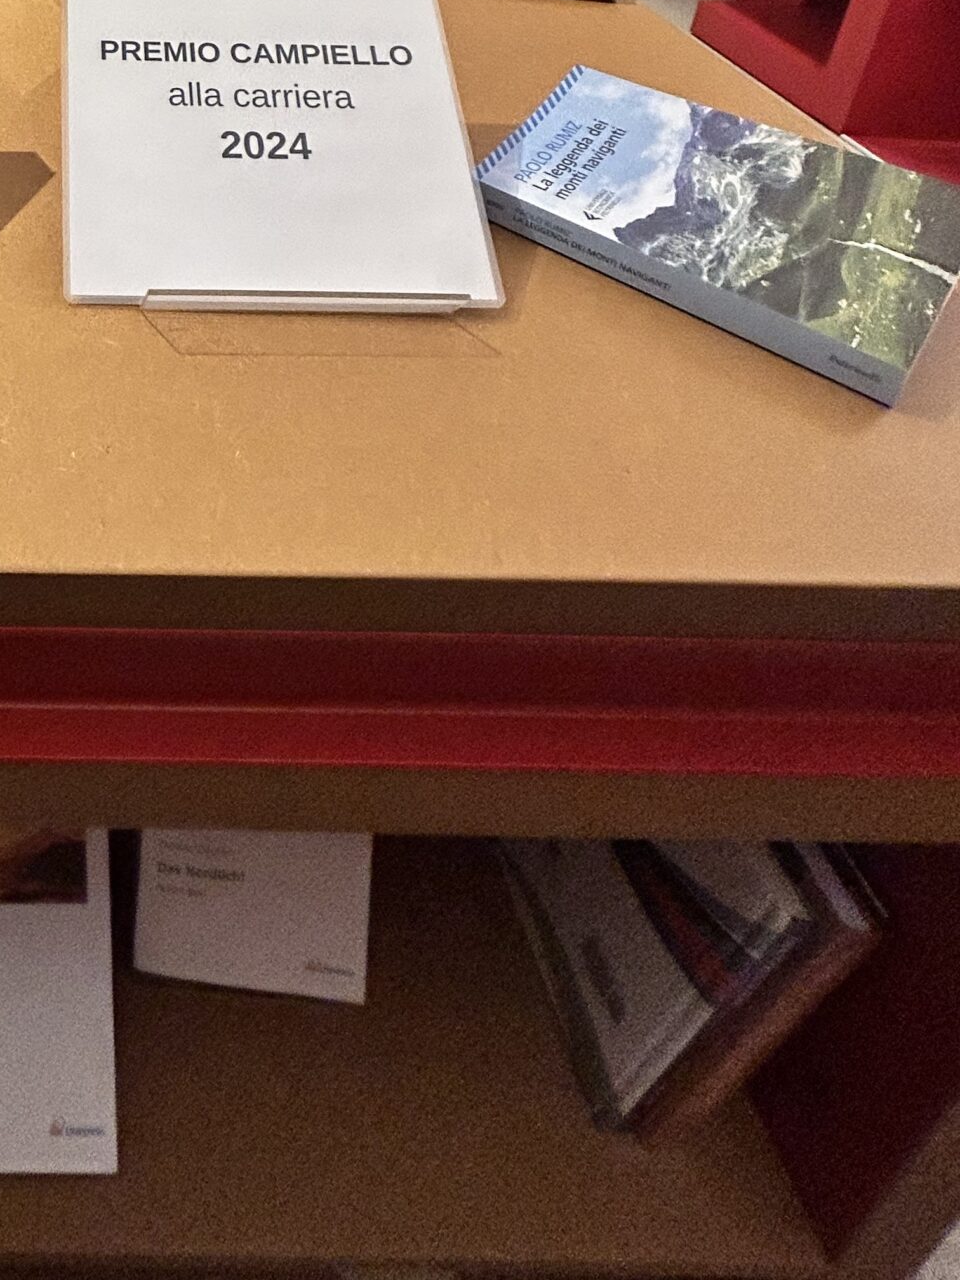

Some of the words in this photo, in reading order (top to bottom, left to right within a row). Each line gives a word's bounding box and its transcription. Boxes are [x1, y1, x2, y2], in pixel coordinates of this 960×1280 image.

[100, 40, 221, 63] PREMIO
[230, 42, 413, 66] CAMPIELLO
[169, 82, 223, 107] alla
[233, 84, 355, 110] carriera
[220, 130, 312, 160] 2024
[513, 151, 552, 184] PAOLO
[545, 120, 583, 153] RUMIZ
[532, 178, 554, 192] La
[543, 136, 594, 179] leggenda
[586, 118, 609, 137] dei
[554, 169, 588, 200] monti
[581, 126, 627, 173] naviganti
